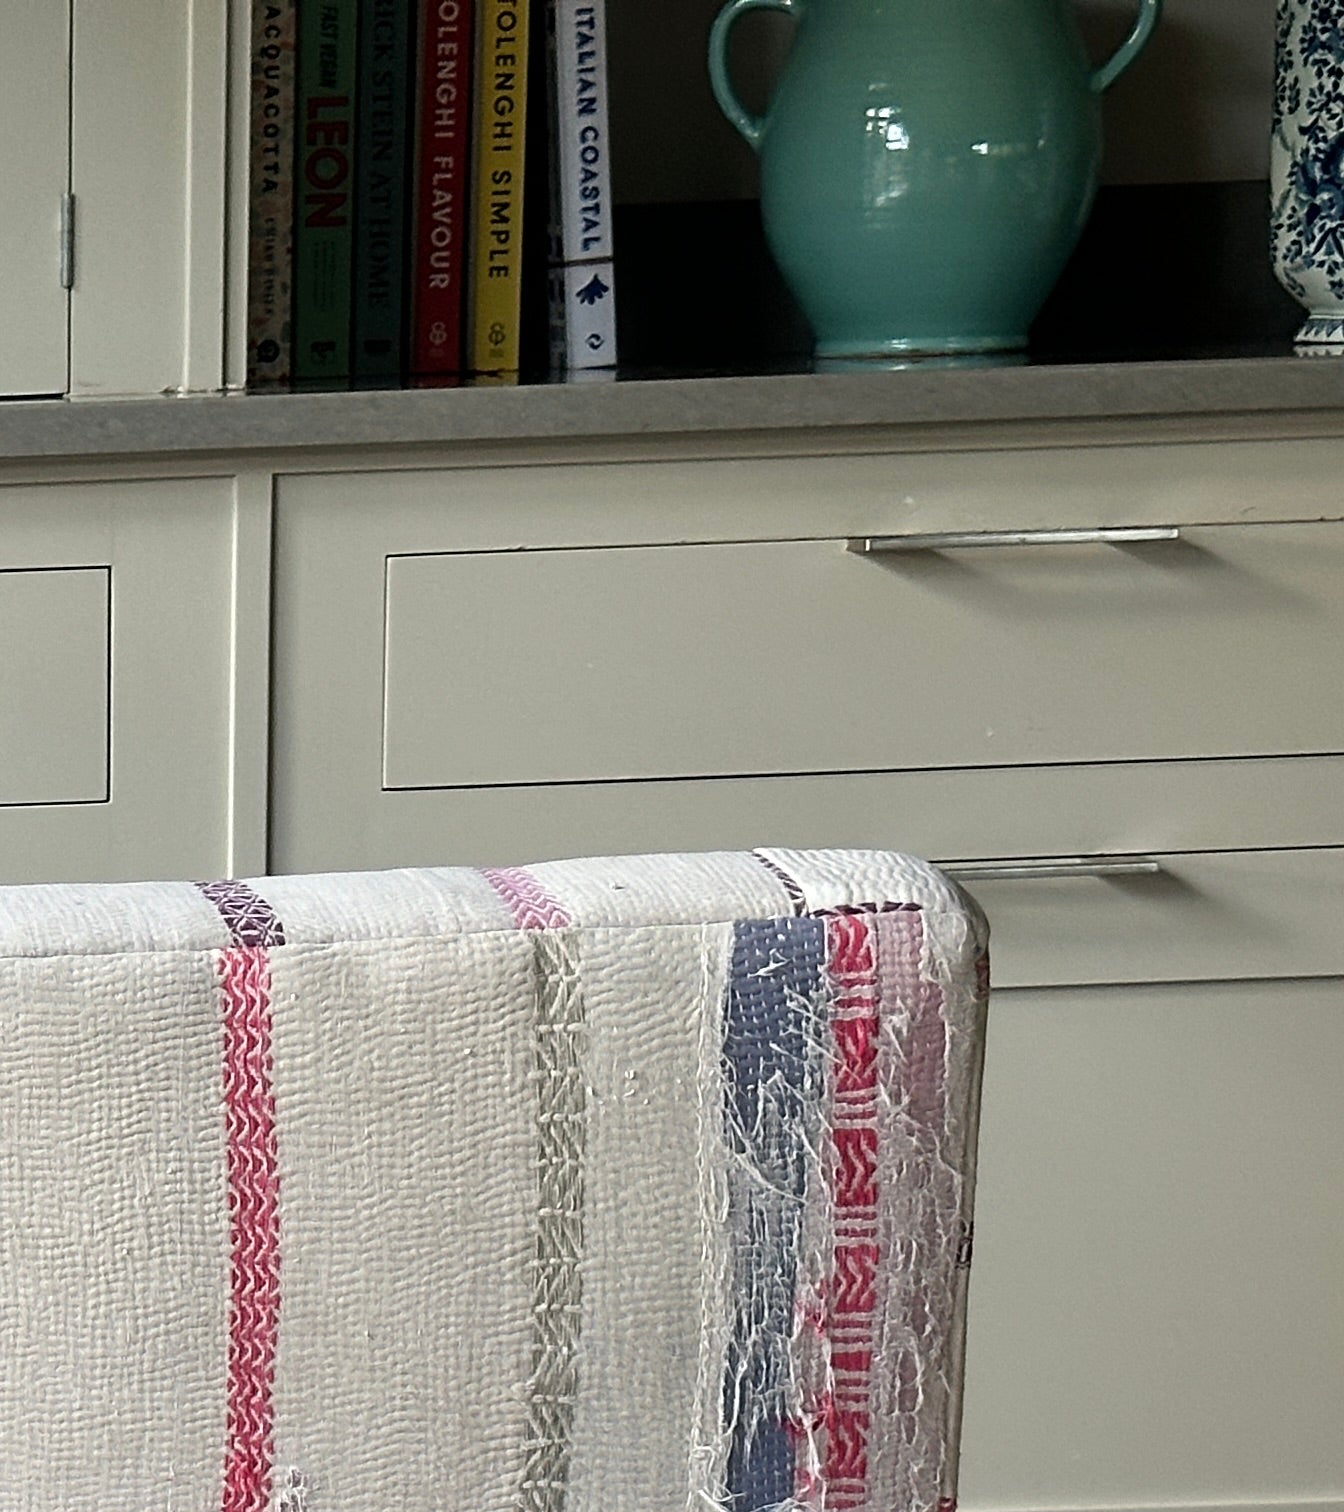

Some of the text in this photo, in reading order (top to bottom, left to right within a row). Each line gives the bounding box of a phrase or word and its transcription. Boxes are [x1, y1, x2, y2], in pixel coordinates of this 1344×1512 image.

[261, 6, 282, 193] ACQUACOTTA
[319, 6, 340, 90] FAST VEGAN
[305, 95, 349, 228] LEON
[371, 70, 394, 161] STEIN
[428, 0, 460, 290] OLENGHI FLAVOUR
[574, 7, 602, 252] ITALIAN COASTAL
[369, 170, 392, 208] AT
[488, 171, 513, 279] SIMPLE
[367, 219, 391, 306] HOME
